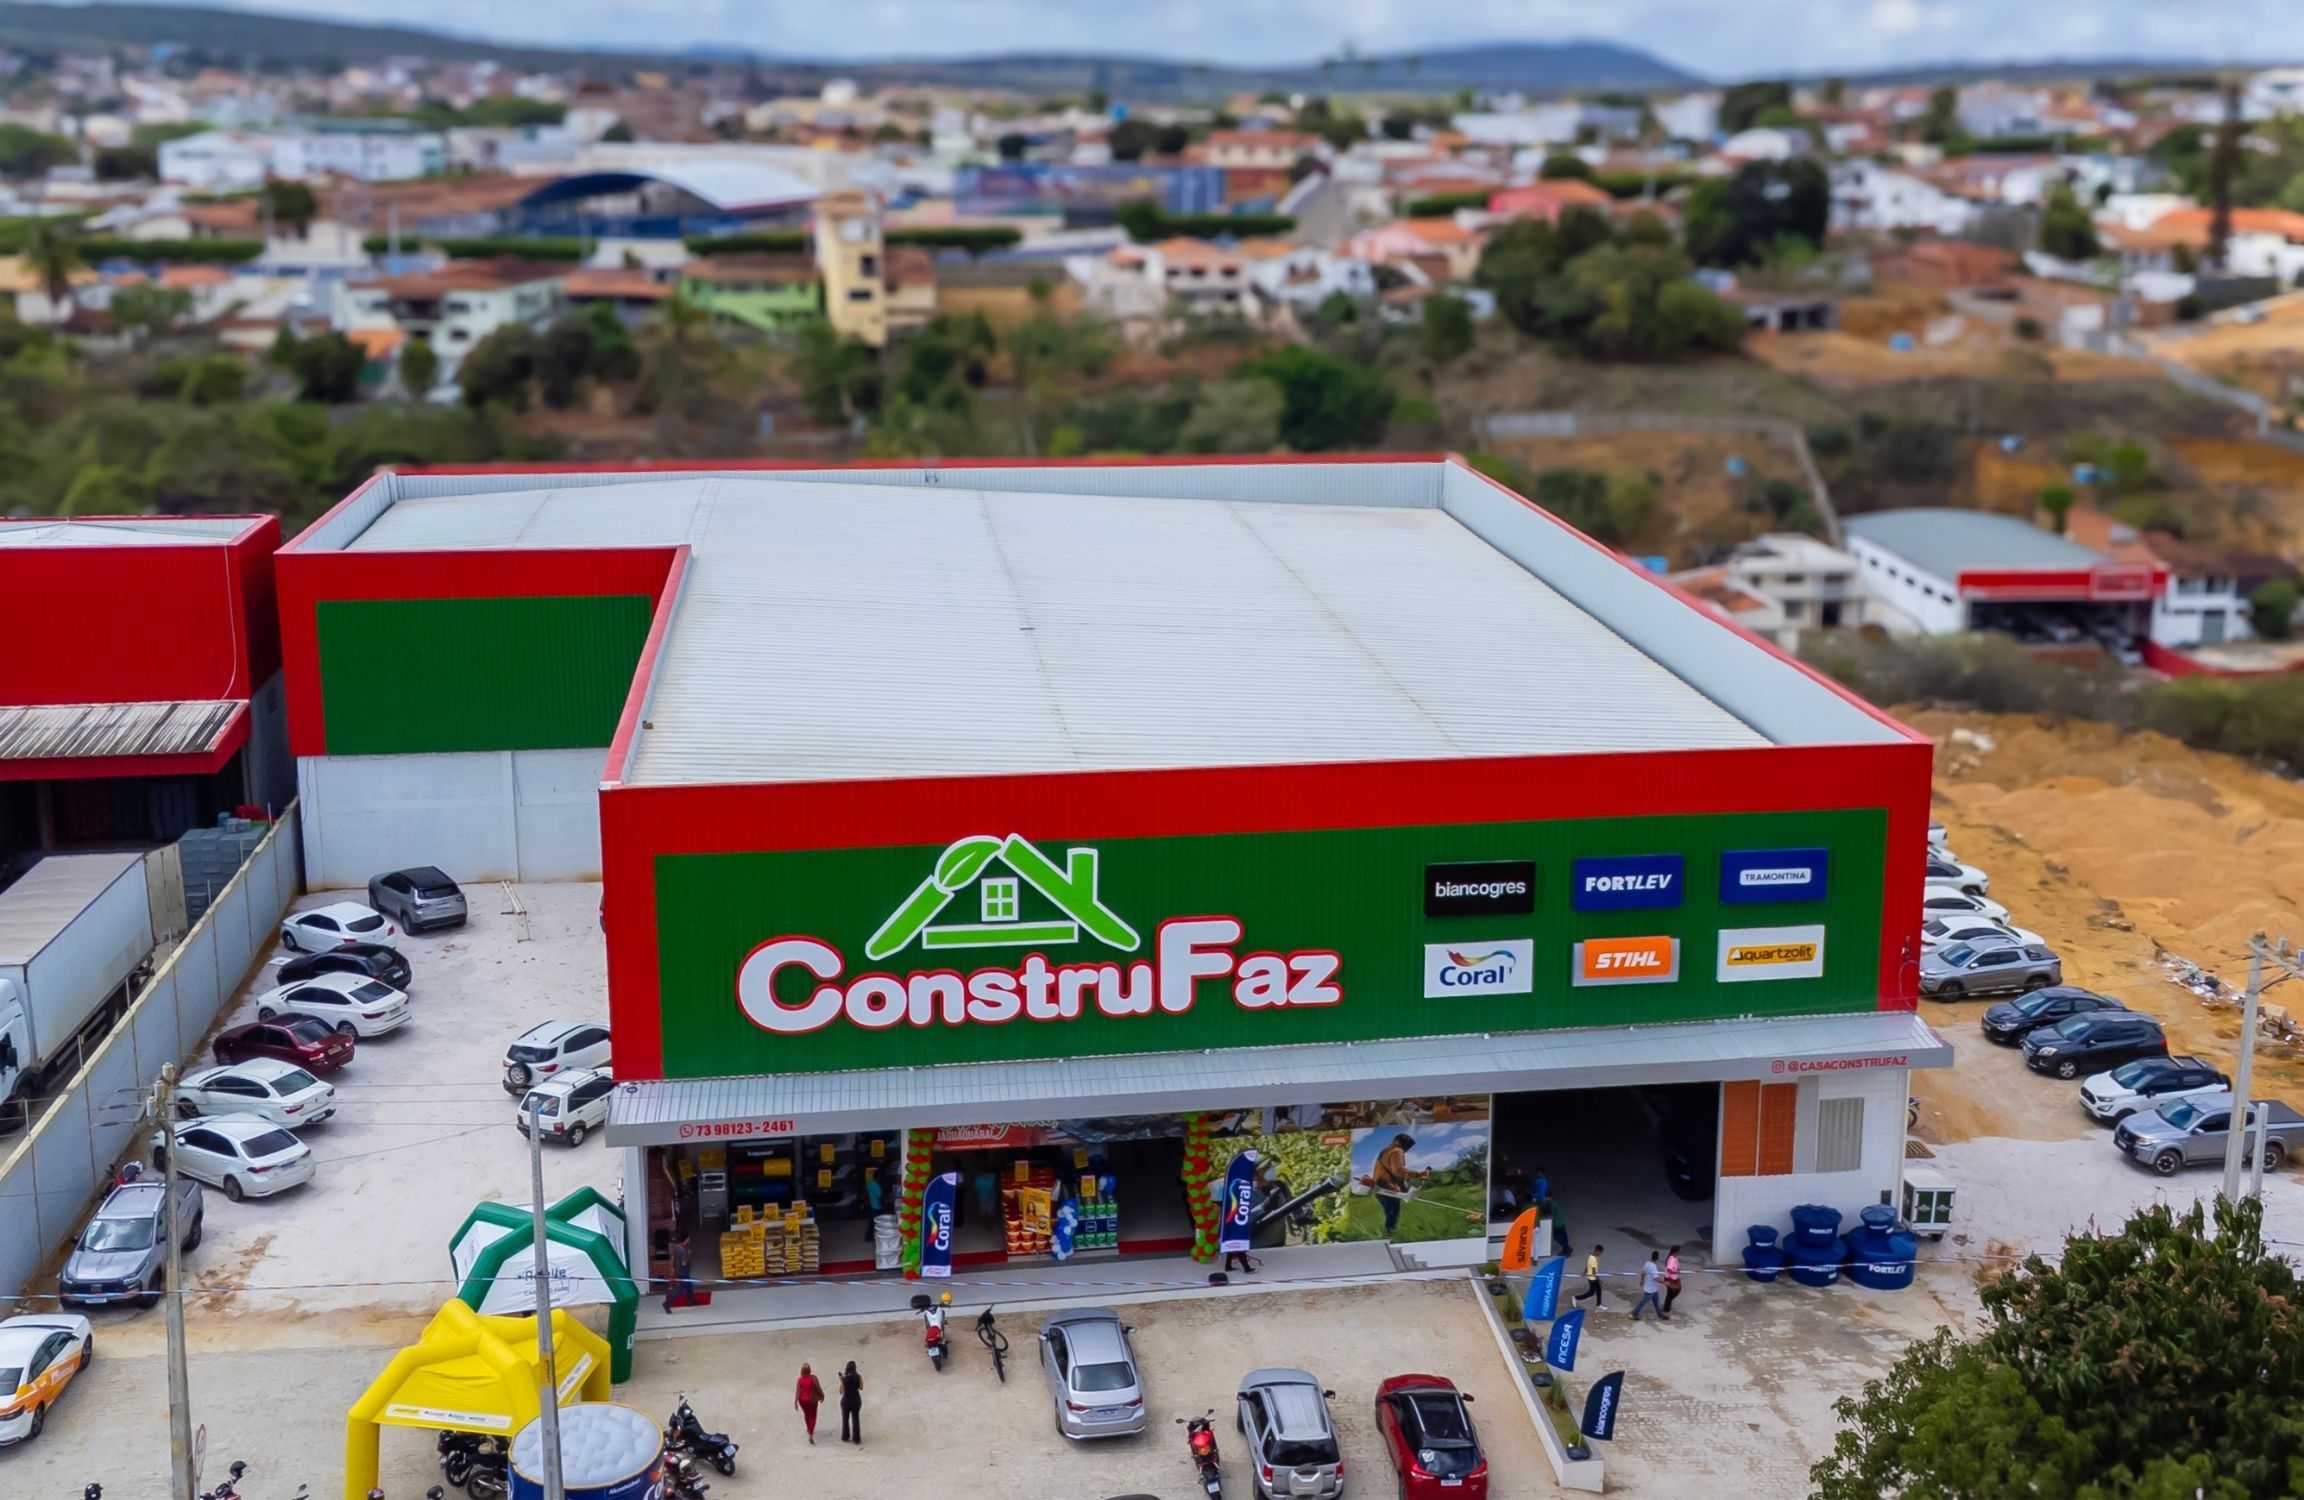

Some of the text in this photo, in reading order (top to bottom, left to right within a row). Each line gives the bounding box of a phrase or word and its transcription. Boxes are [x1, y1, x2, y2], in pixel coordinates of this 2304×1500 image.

[1585, 873, 1672, 892] FORTLEV
[1744, 870, 1807, 882] TRAMONTINA
[1435, 879, 1526, 899] biancogres
[1594, 950, 1661, 969] STIHL
[1744, 945, 1812, 961] quartzolit
[737, 916, 1341, 1034] ConstruFaz
[1439, 964, 1506, 987] Coral
[1788, 1056, 1908, 1072] @CASACONSTRUFAZ
[695, 1125, 711, 1136] 73
[1235, 1184, 1251, 1226] Coral
[935, 1207, 951, 1250] Coral
[1869, 1265, 1907, 1274] FORTLEV
[1557, 1323, 1573, 1364] INCESA
[1594, 1385, 1612, 1435] biancogres
